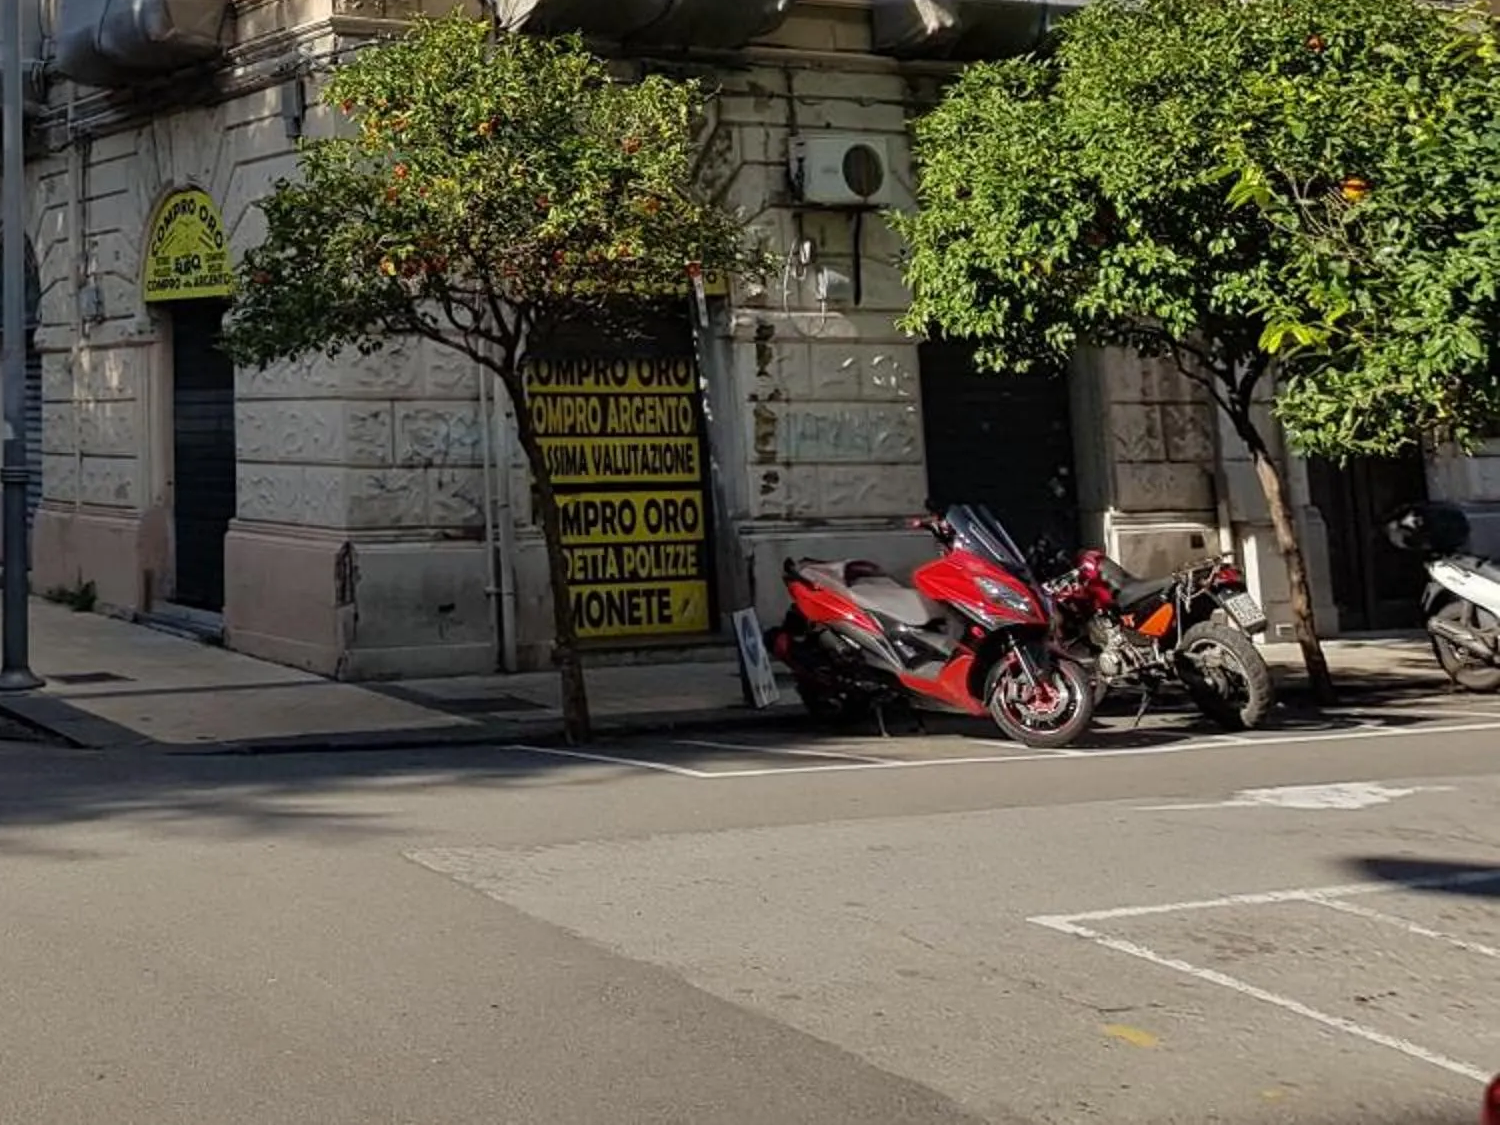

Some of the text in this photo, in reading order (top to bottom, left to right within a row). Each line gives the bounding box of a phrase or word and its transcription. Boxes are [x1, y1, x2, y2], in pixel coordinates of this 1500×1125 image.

[151, 198, 223, 257] COMPRO ORO
[528, 358, 691, 387] OMPRO ORO
[527, 395, 692, 435] OMPRO ARGENTO
[545, 443, 695, 475] SSIMA VALUTAZIONE
[562, 498, 698, 535] MPRO ORO
[622, 544, 698, 580] POLIZZE
